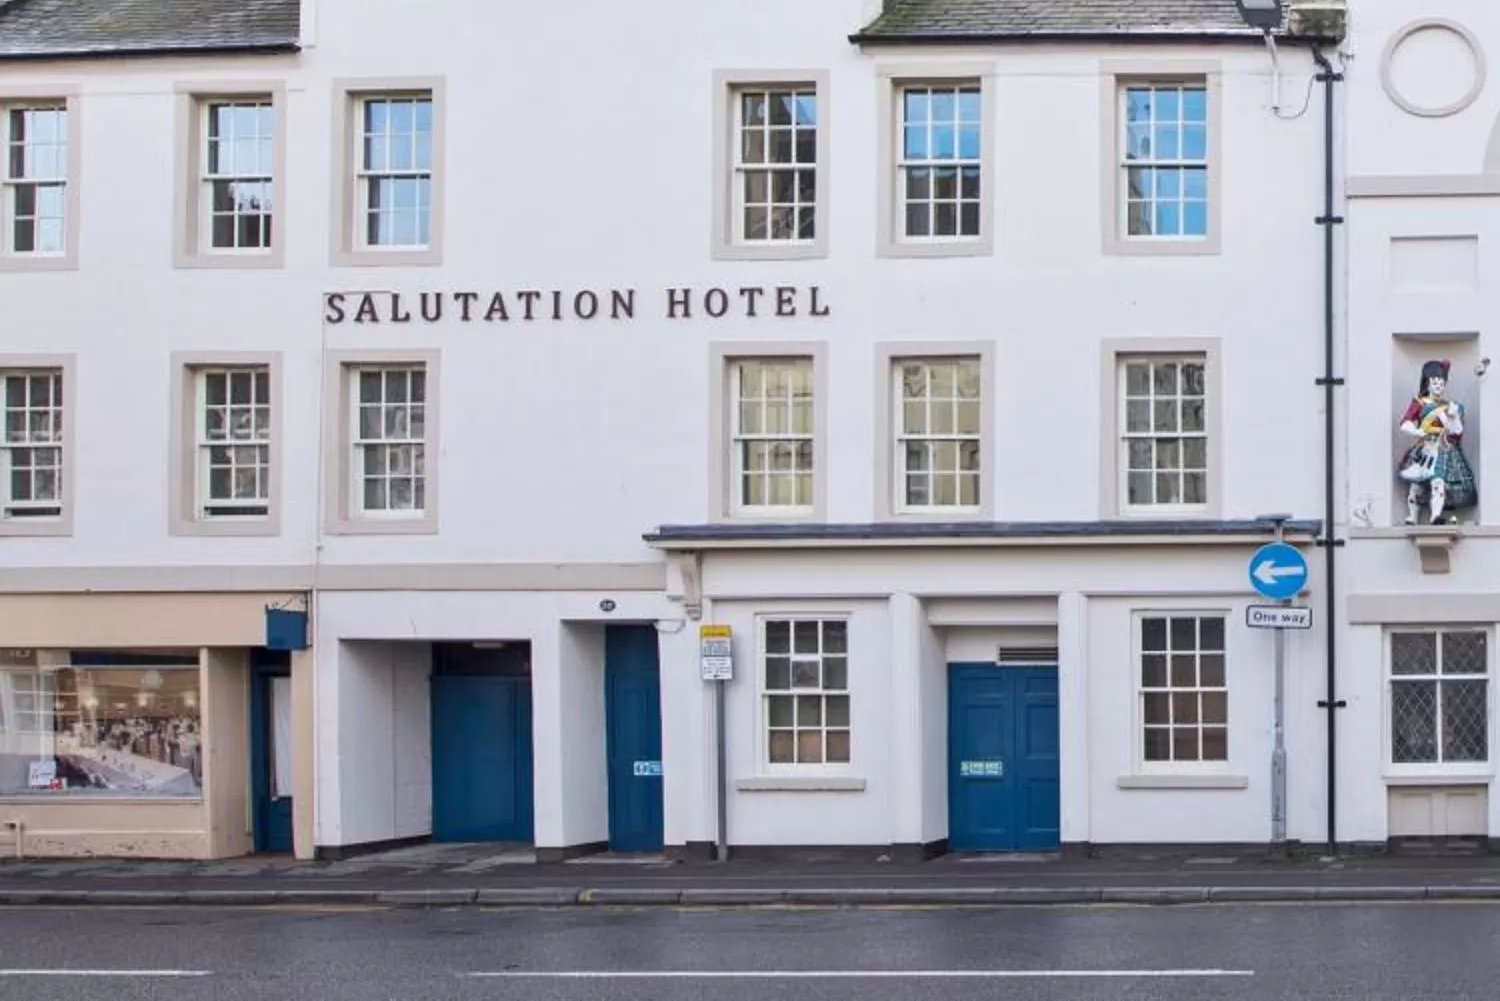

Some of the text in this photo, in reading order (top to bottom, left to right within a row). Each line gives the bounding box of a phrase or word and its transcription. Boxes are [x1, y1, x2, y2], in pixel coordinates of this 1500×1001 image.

[323, 286, 830, 324] SALUTATION HOTEL
[1253, 610, 1305, 624] One way
